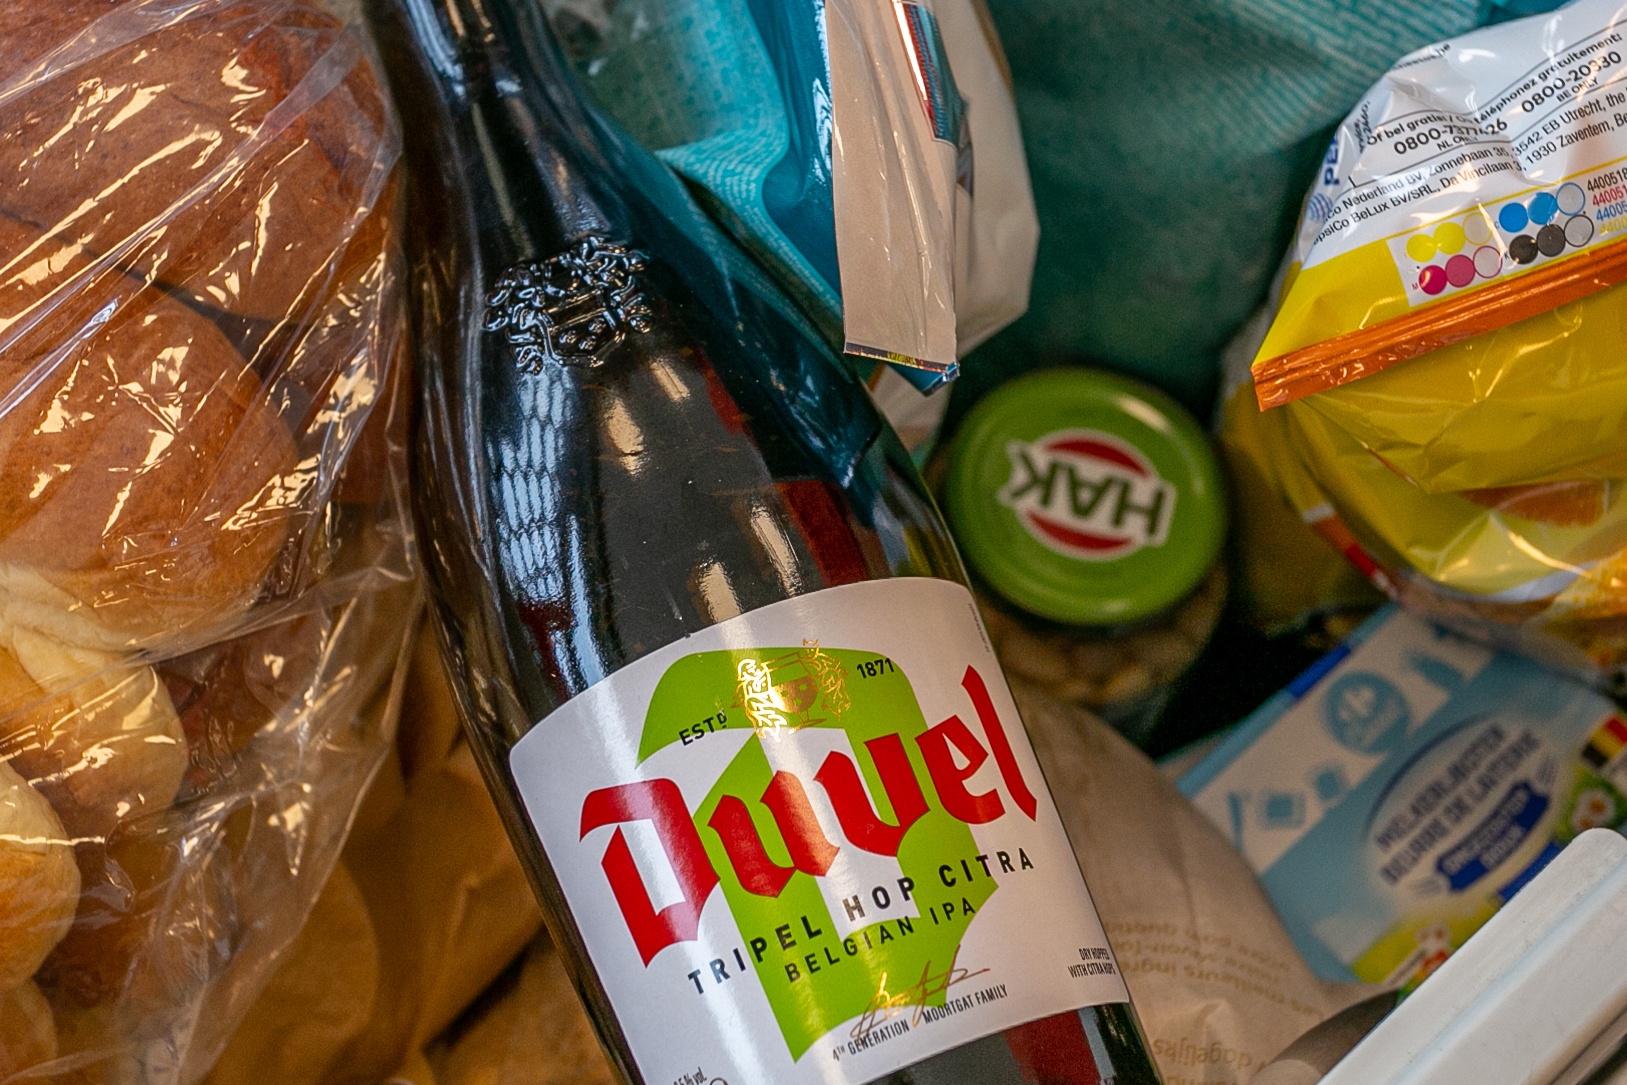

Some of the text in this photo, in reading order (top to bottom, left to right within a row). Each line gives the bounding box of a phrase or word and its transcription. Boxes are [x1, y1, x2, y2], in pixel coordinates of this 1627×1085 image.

[1521, 50, 1622, 113] 0800-20330
[1556, 76, 1599, 102] BE ONLY
[1342, 178, 1404, 210] Nederland
[1405, 171, 1427, 185] BV,
[1428, 147, 1493, 177] Zonnebaan
[1493, 145, 1513, 159] 35,
[1511, 131, 1544, 157] 3542
[1542, 119, 1560, 135] EB
[1559, 99, 1607, 125] Utrecht,
[1605, 90, 1626, 108] the
[1367, 133, 1383, 146] Of
[1386, 123, 1405, 140] bel
[1436, 140, 1452, 151] NL
[1350, 201, 1390, 223] BeLux
[1389, 183, 1442, 207] BV/SRL,
[1439, 175, 1460, 190] Da
[1459, 160, 1514, 183] Vincilaan
[1525, 141, 1558, 165] 1930
[1555, 120, 1615, 148] Zaventem,
[1411, 283, 1419, 291] M
[1009, 450, 1166, 540] HAK
[856, 656, 896, 680] 1871
[578, 663, 1038, 970] Duvel
[687, 914, 824, 995] TRIPEL
[842, 875, 917, 922] HOP
[937, 846, 1035, 889] CITRA
[784, 896, 977, 984] BELGIAN IPA
[1067, 963, 1089, 978] WITH
[847, 1018, 910, 1056] GENERATION
[922, 994, 973, 1024] MOORTGAT
[972, 983, 1009, 1006] FAMILY
[1152, 1036, 1253, 1070] dagelijks
